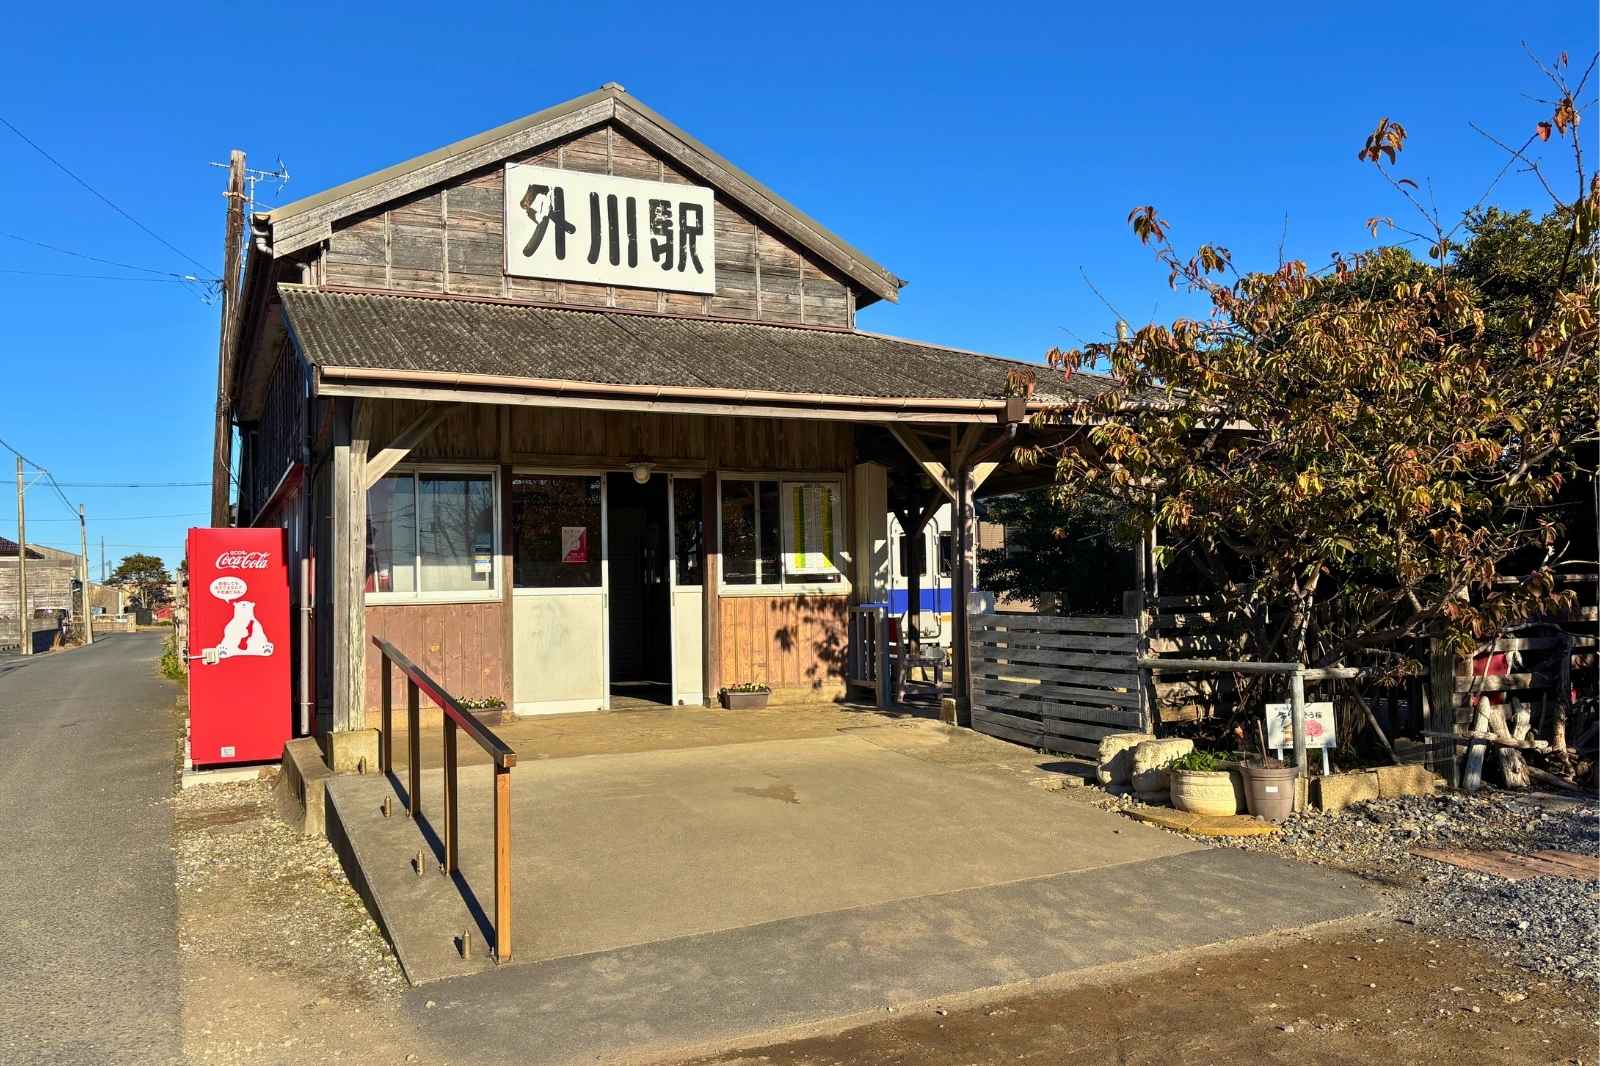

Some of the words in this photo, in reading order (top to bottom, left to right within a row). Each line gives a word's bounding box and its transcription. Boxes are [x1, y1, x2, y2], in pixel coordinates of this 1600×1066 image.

[520, 184, 704, 274] 外川駅
[215, 552, 270, 569] Coca-Cola
